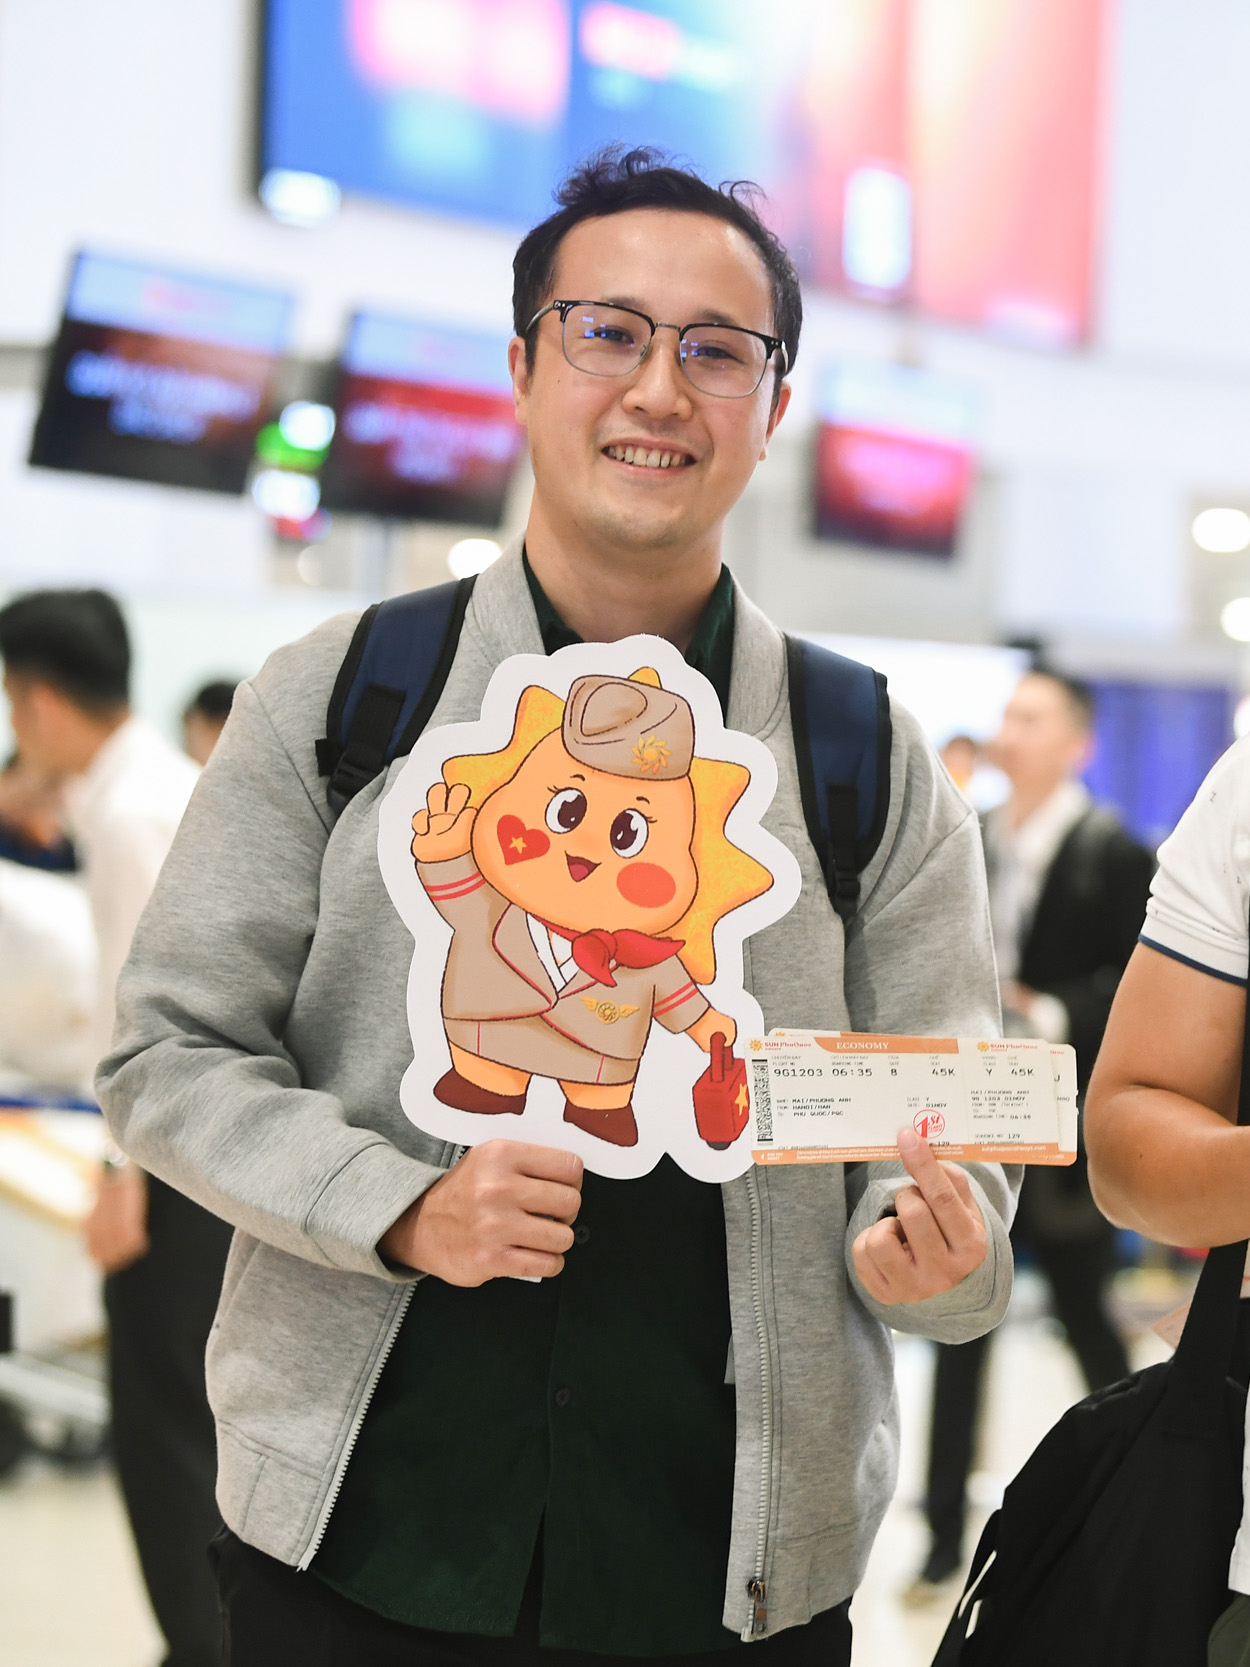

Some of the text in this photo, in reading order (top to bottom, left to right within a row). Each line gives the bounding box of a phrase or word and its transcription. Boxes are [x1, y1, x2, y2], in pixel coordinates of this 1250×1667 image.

[836, 1041, 889, 1050] ECONOMY
[773, 1068, 955, 1077] 9G1203 06:35 8 45K
[985, 1068, 1034, 1076] Y 45K
